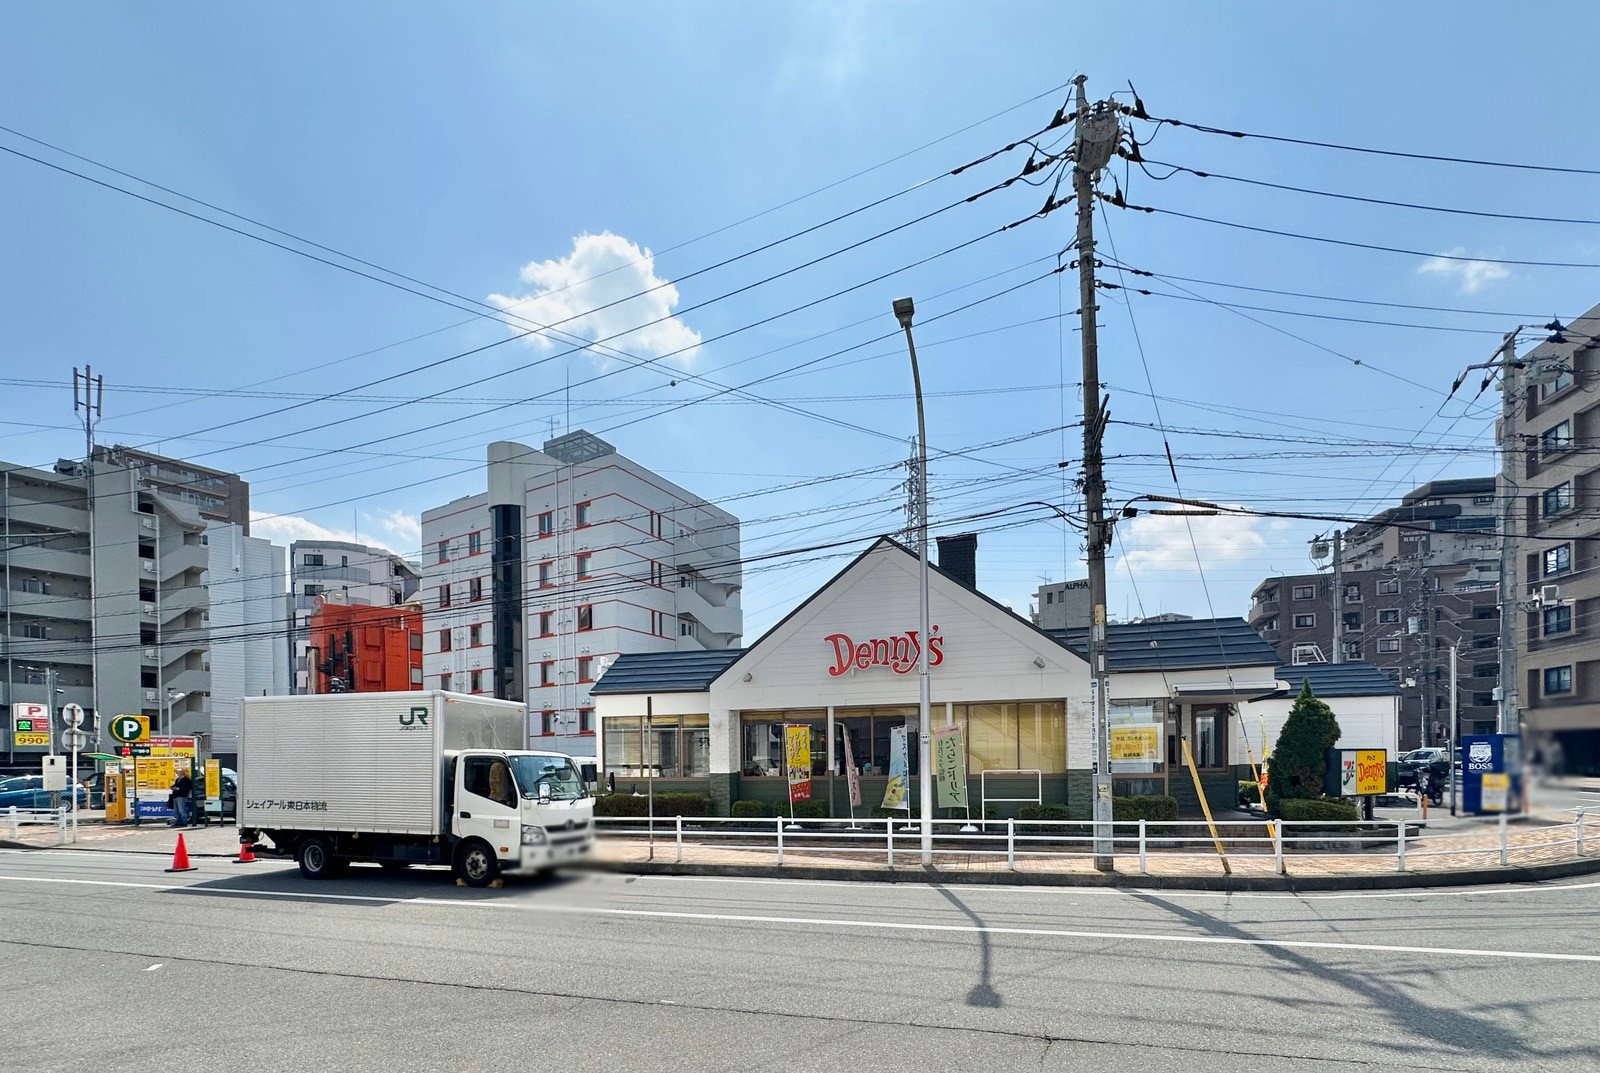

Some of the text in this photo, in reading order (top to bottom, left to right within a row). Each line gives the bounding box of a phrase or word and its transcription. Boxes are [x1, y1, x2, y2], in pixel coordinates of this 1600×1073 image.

[1065, 581, 1089, 590] ALPHA
[823, 624, 944, 677] Denny's
[28, 706, 42, 715] P
[399, 707, 428, 725] JR
[123, 720, 139, 738] P
[1358, 760, 1384, 782] Denny's
[1468, 762, 1493, 770] BOSS
[246, 799, 328, 811] ジェイアール東日本物流
